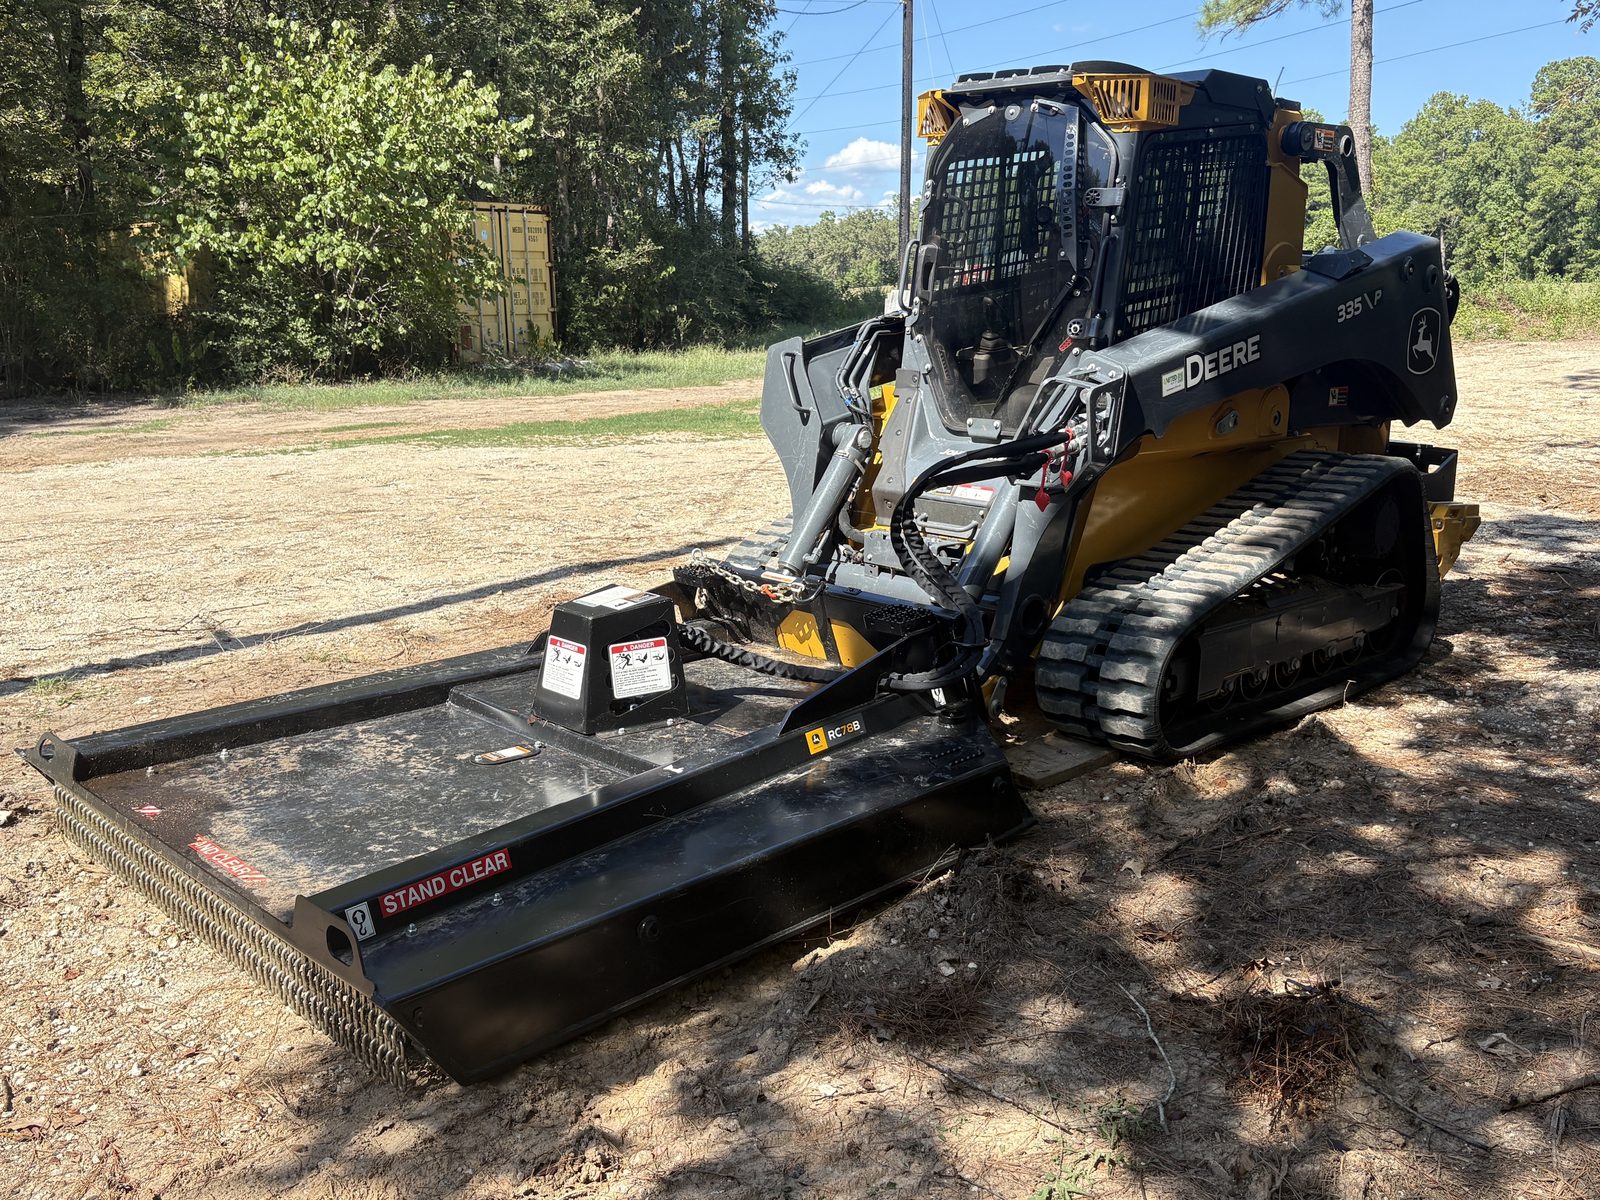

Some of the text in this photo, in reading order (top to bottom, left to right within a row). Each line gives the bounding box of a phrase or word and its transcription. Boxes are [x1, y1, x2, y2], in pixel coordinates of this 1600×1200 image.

[1337, 296, 1363, 323] 335
[1186, 334, 1260, 389] DEERE
[629, 641, 655, 651] DANGER
[827, 720, 861, 741] RC78B
[212, 852, 252, 876] CLEAR
[383, 851, 509, 914] STAND CLEAR
